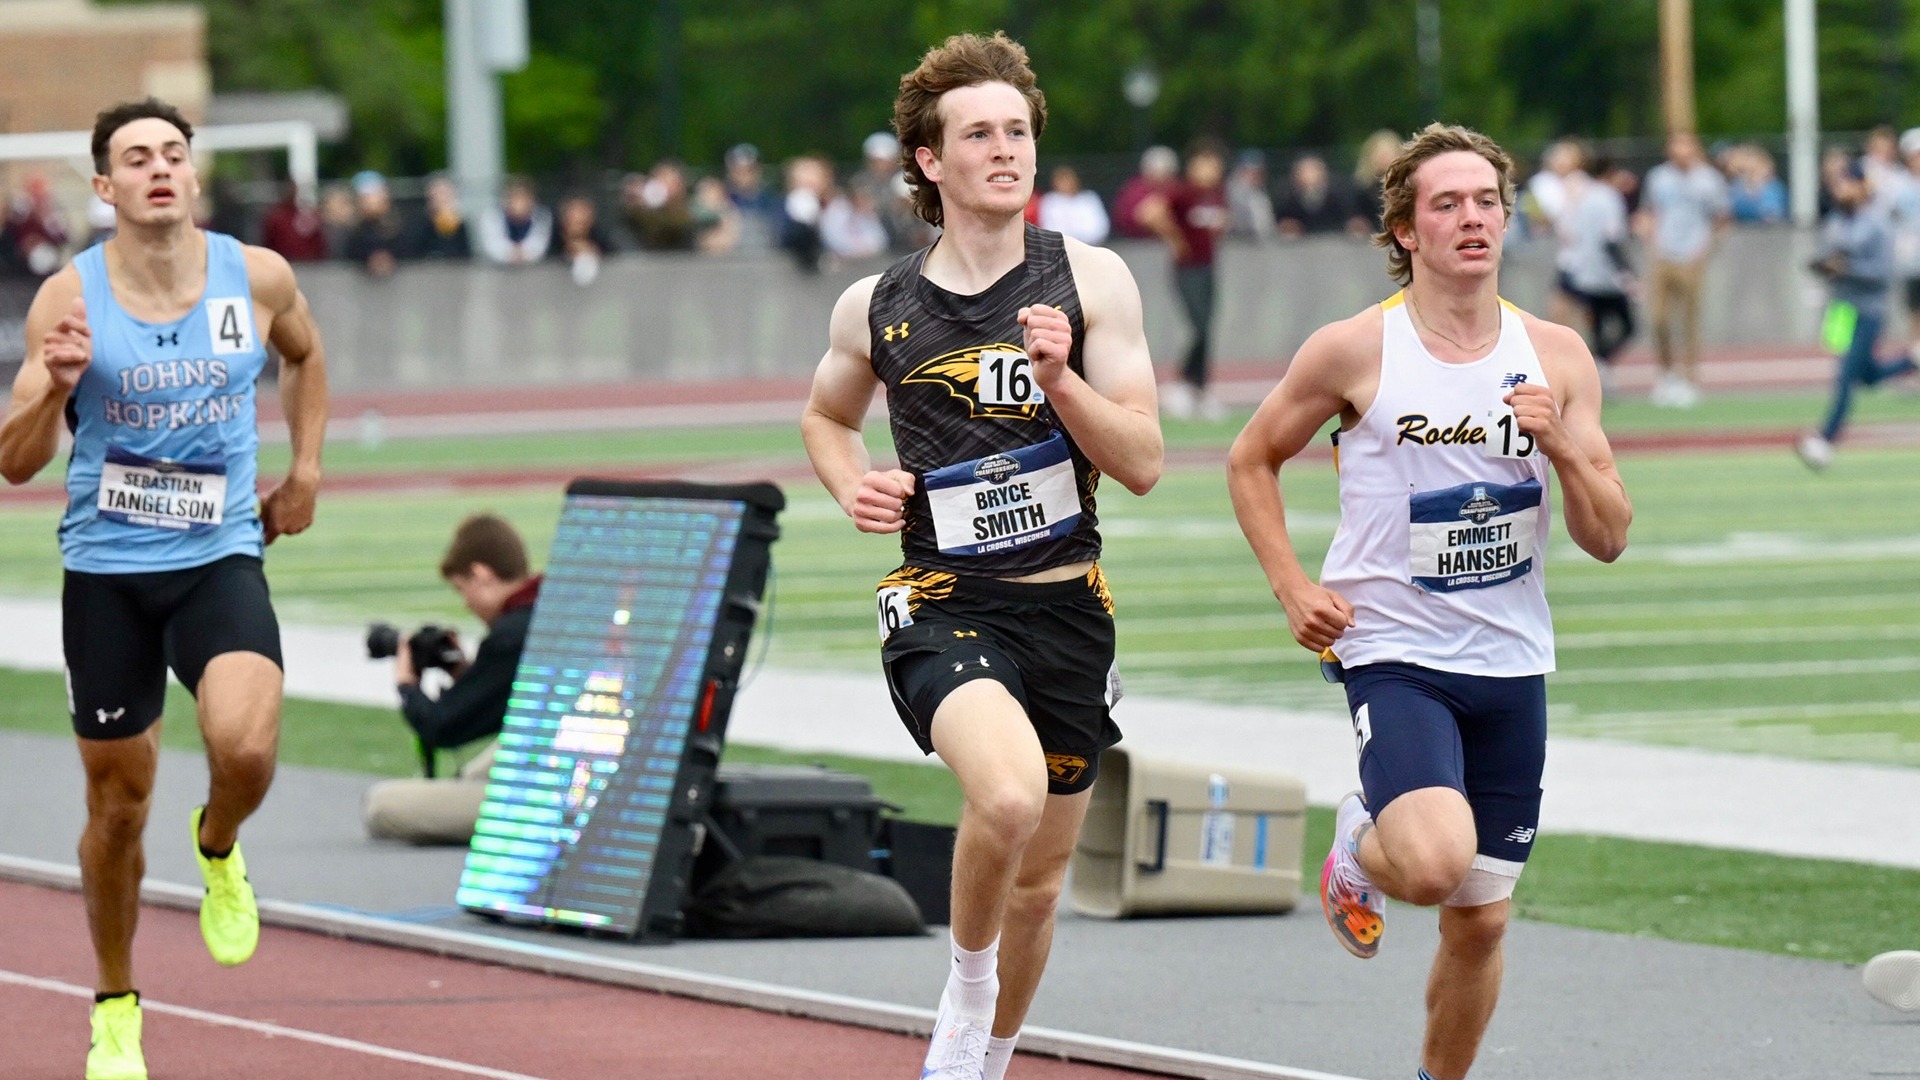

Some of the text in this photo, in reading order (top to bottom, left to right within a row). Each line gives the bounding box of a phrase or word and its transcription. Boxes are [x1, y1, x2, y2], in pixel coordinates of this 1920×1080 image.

[219, 304, 243, 348] 4
[118, 358, 230, 396] JOHNS
[989, 357, 1031, 403] 16
[1396, 413, 1487, 446] Roche
[1497, 414, 1535, 458] 15
[123, 471, 203, 494] SEBASTIAN
[975, 482, 1032, 511] BRYCE
[107, 489, 215, 520] TANGELSON
[972, 503, 1047, 541] SMITH
[1447, 522, 1512, 547] EMMETT
[977, 529, 1051, 554] LA CROSSE, WISCONSIN
[1437, 542, 1518, 576] HANSEN
[1447, 578, 1455, 587] LA
[1481, 569, 1512, 583] WISCONSIN
